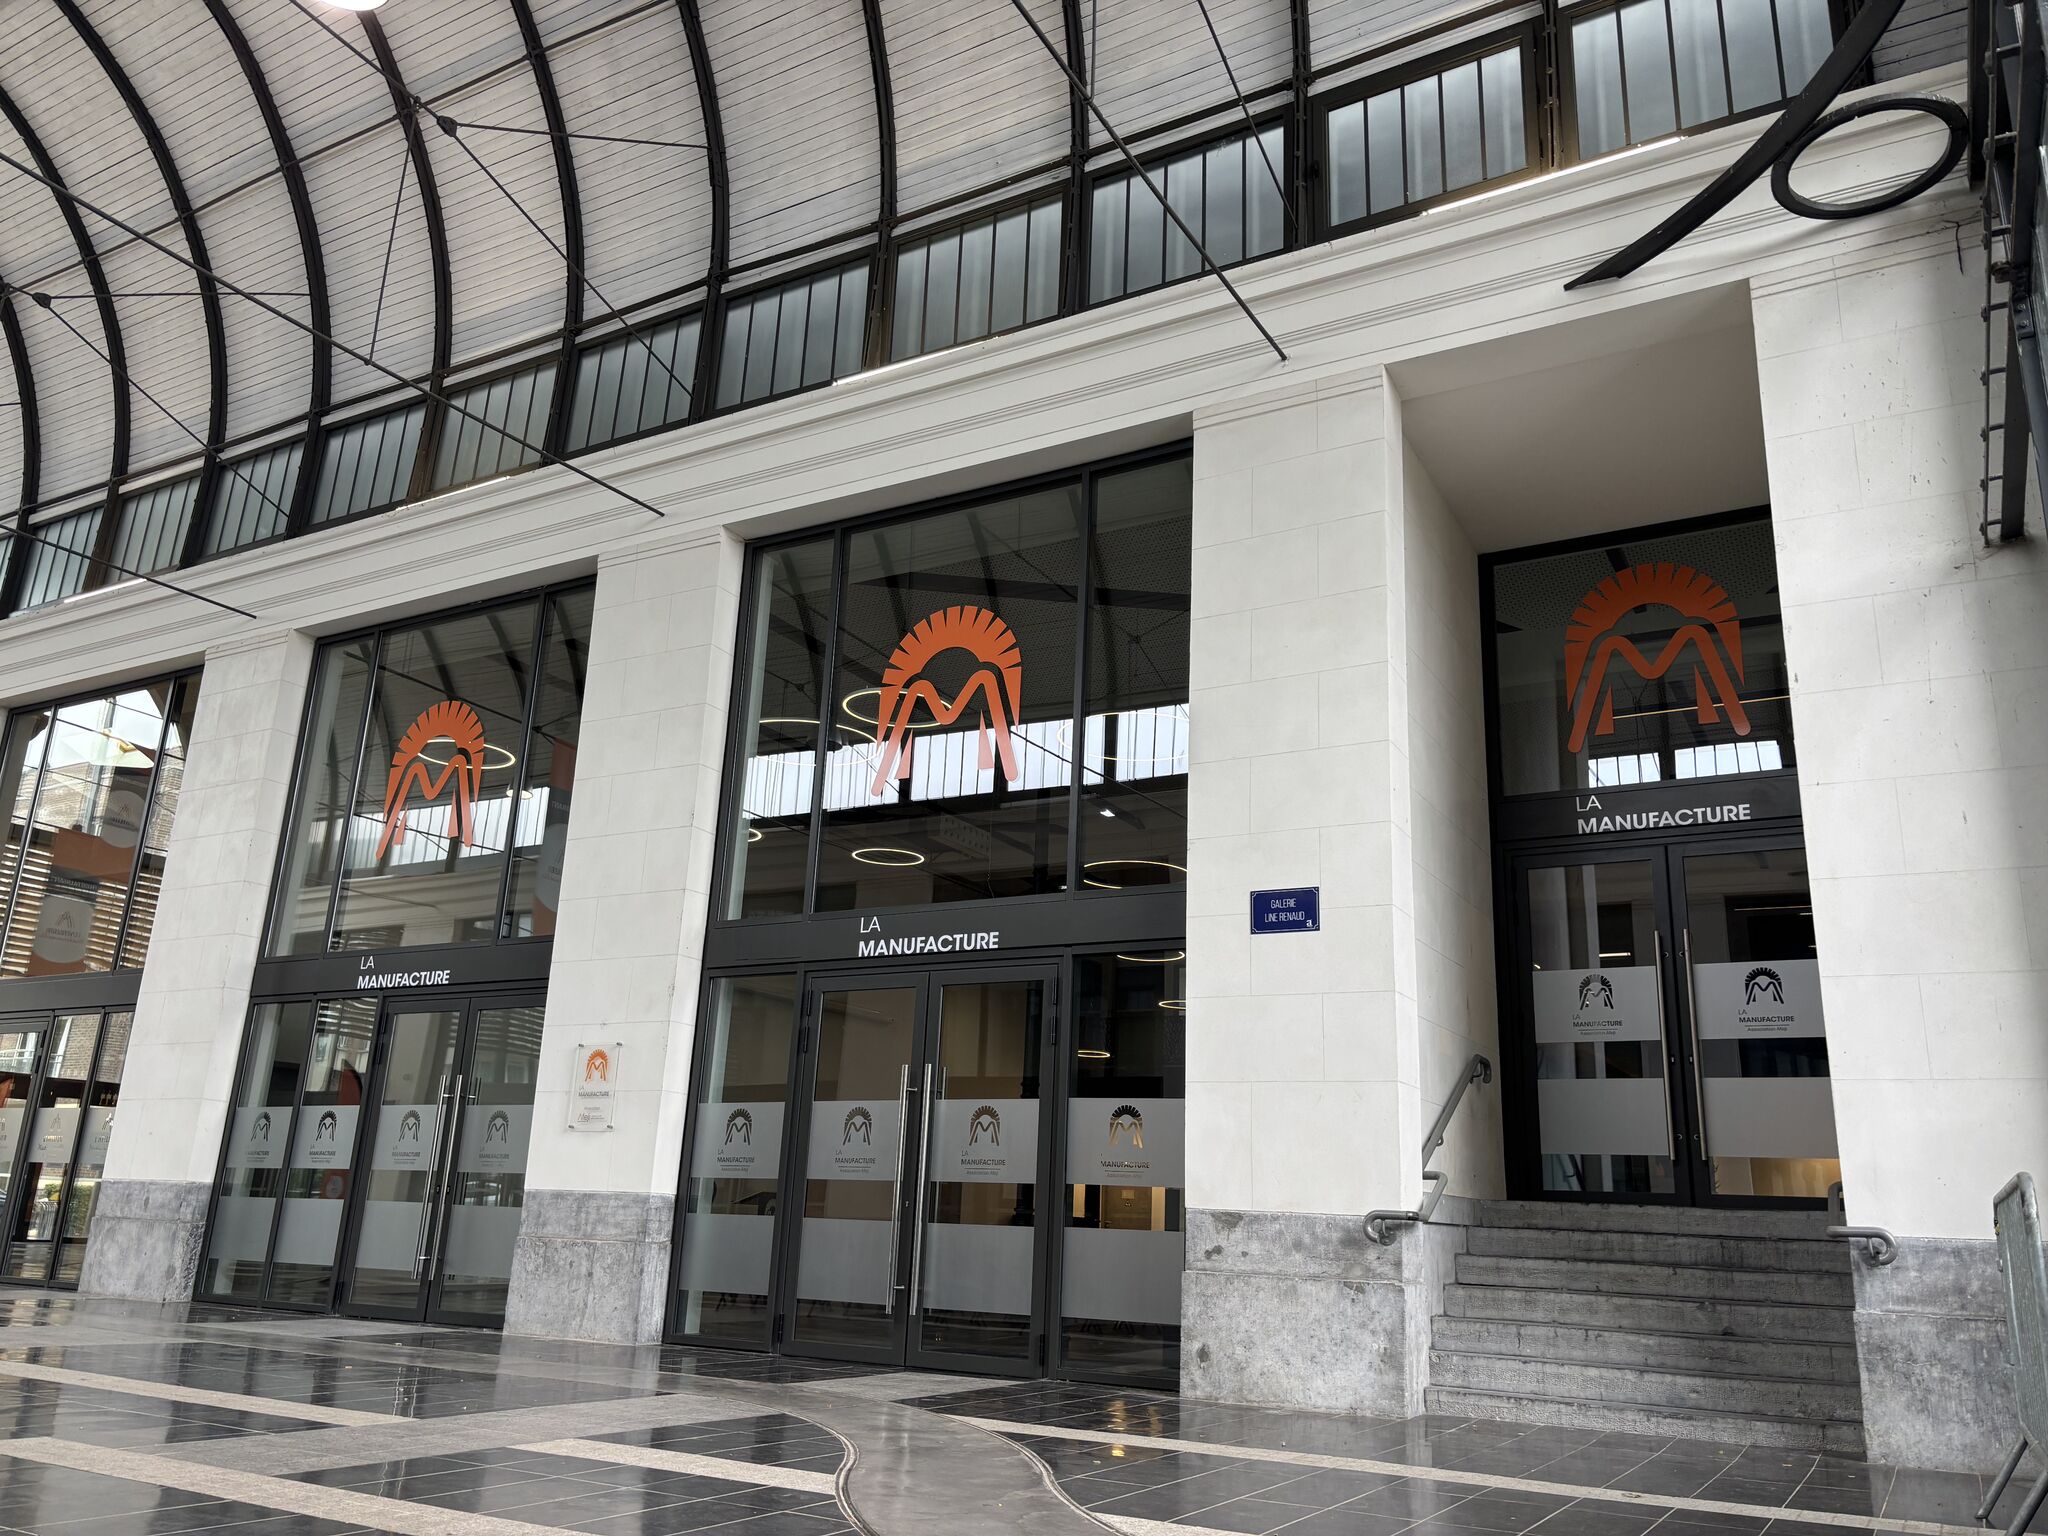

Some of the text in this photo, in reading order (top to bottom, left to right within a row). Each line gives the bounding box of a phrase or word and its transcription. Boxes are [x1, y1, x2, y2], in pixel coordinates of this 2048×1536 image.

[1576, 794, 1602, 812] LA
[1577, 803, 1752, 835] MANUFACTURE
[1270, 898, 1297, 909] GALERIE
[1264, 911, 1305, 923] LINE RENAUD
[860, 916, 881, 933] LA
[858, 931, 1000, 958] MANUFACTURE
[360, 955, 375, 970] LA
[357, 970, 451, 990] MANUFACTURE
[1738, 1015, 1795, 1023] MANUFACTURE
[716, 1156, 755, 1164] MANUFACTURE
[834, 1157, 876, 1165] MANUFACTURE
[960, 1158, 1006, 1166] MANUFACTURE
[1100, 1160, 1151, 1169] MANUFACTURE
